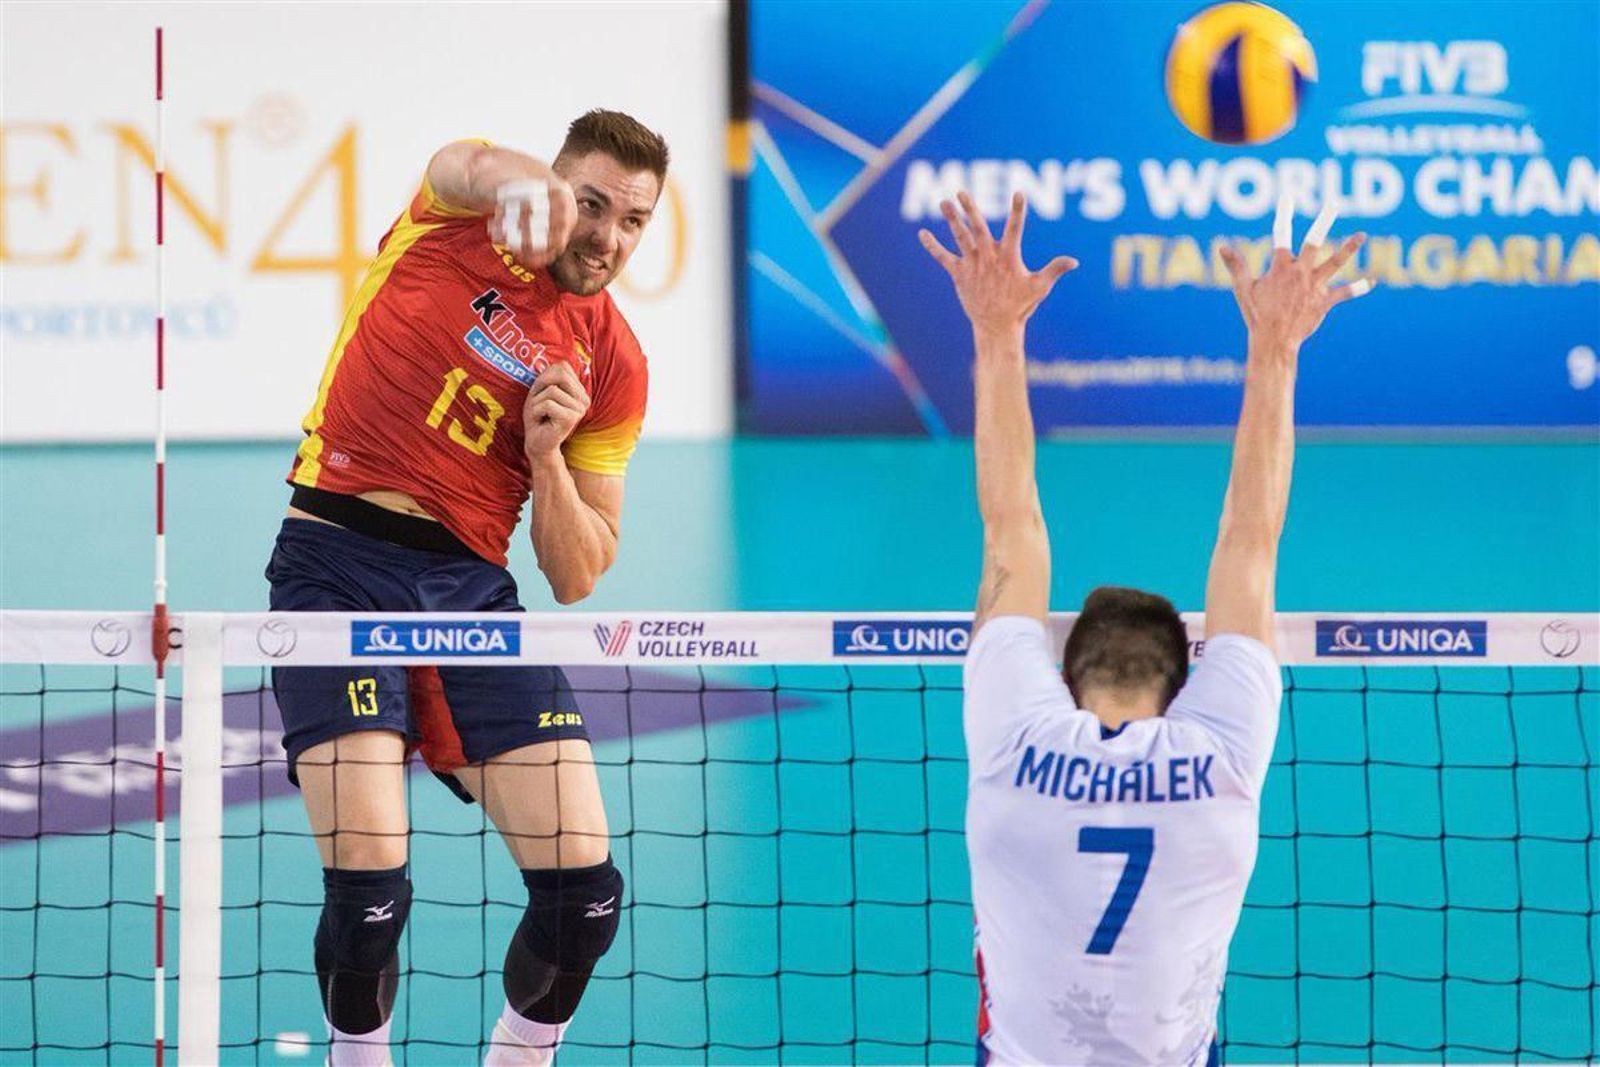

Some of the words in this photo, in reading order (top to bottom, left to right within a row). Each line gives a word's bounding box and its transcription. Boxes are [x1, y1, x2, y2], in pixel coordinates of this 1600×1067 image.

[1361, 40, 1509, 96] FIVB
[1325, 124, 1545, 157] VOLLEYBALL
[901, 157, 1126, 221] MEN'S
[1139, 156, 1404, 219] WORLD
[425, 367, 506, 457] 13
[412, 628, 509, 652] UNIQA
[639, 621, 704, 637] CZECH
[1377, 628, 1474, 652] UNIQA
[637, 640, 760, 658] VOLLEYBALL
[347, 678, 378, 717] 13
[1014, 745, 1215, 803] MICHÁLEK
[1077, 826, 1155, 955] 7
